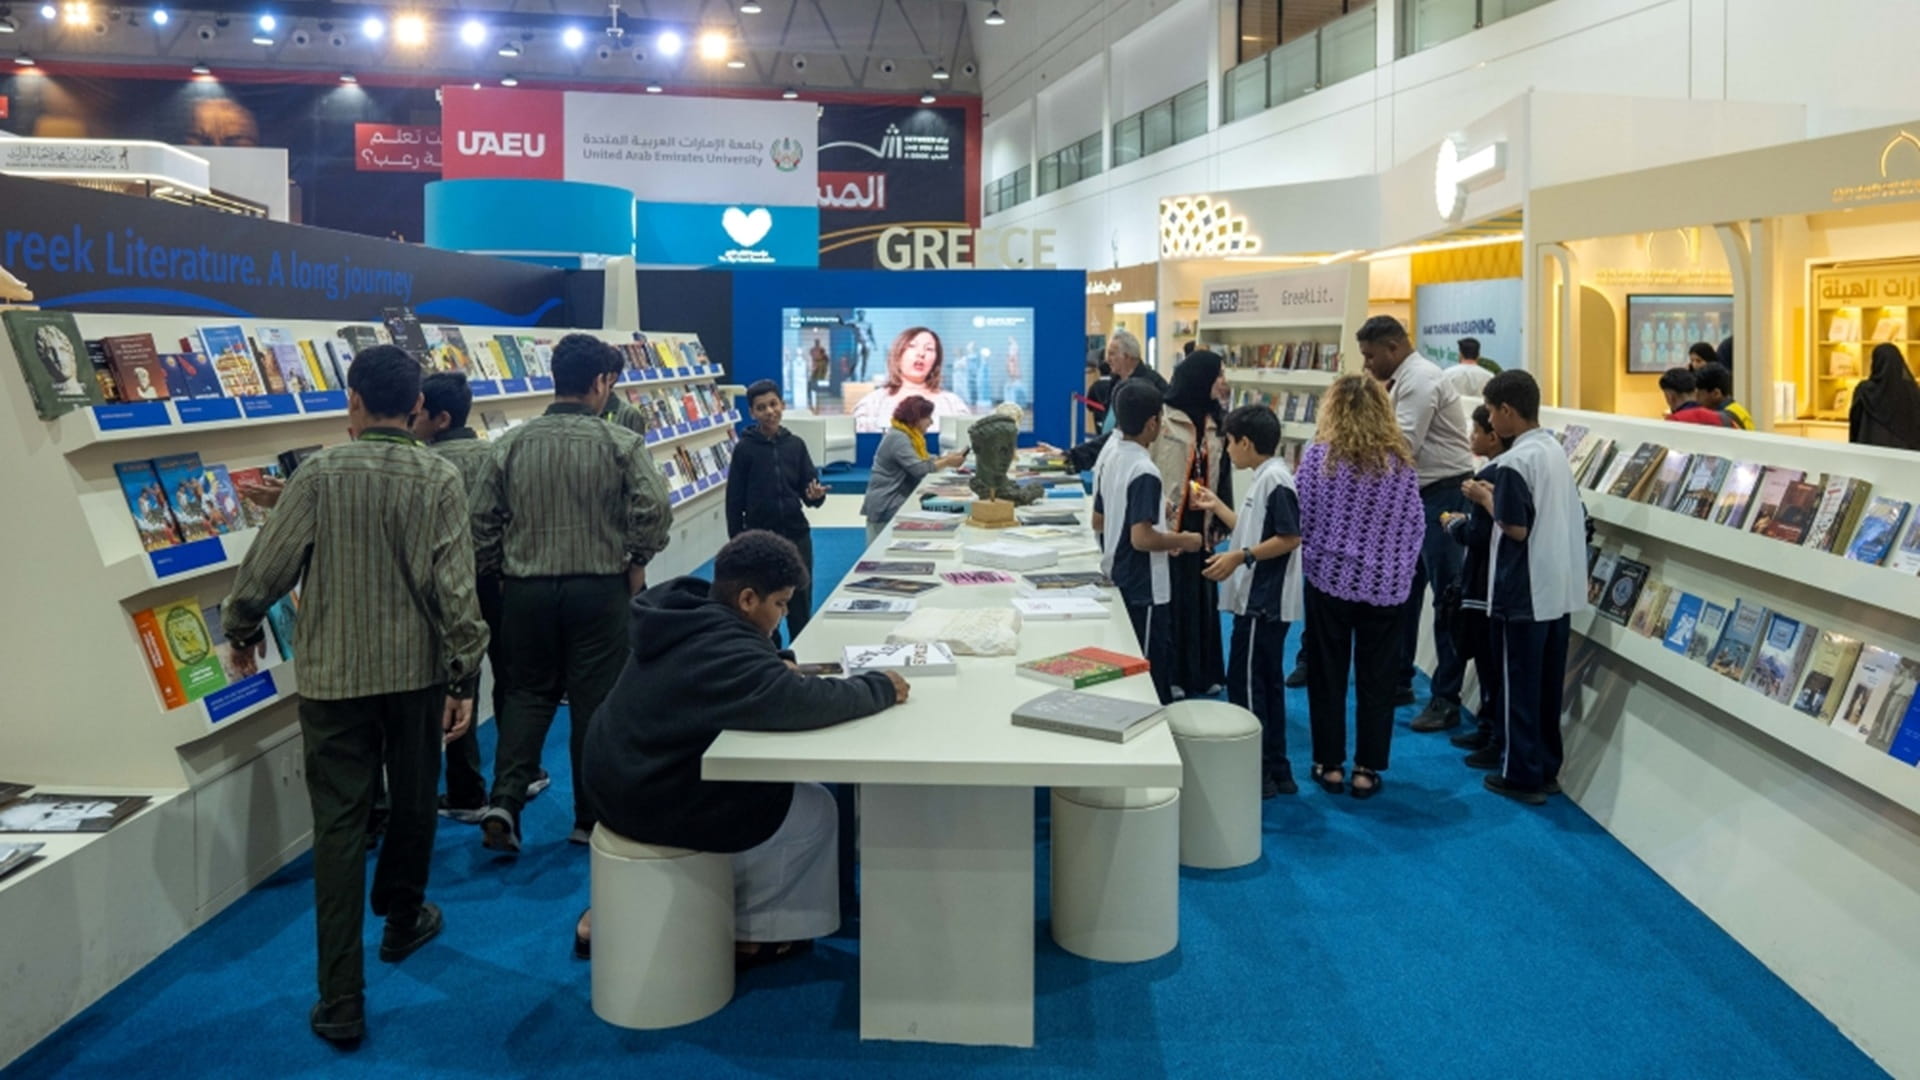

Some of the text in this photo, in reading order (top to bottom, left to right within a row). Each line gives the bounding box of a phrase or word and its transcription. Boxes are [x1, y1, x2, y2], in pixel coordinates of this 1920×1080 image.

[457, 130, 546, 158] UAEU
[583, 149, 763, 167] United Arab Emirates University
[5, 223, 414, 304] reek Literature. A long journey
[877, 227, 1057, 270] GREECE
